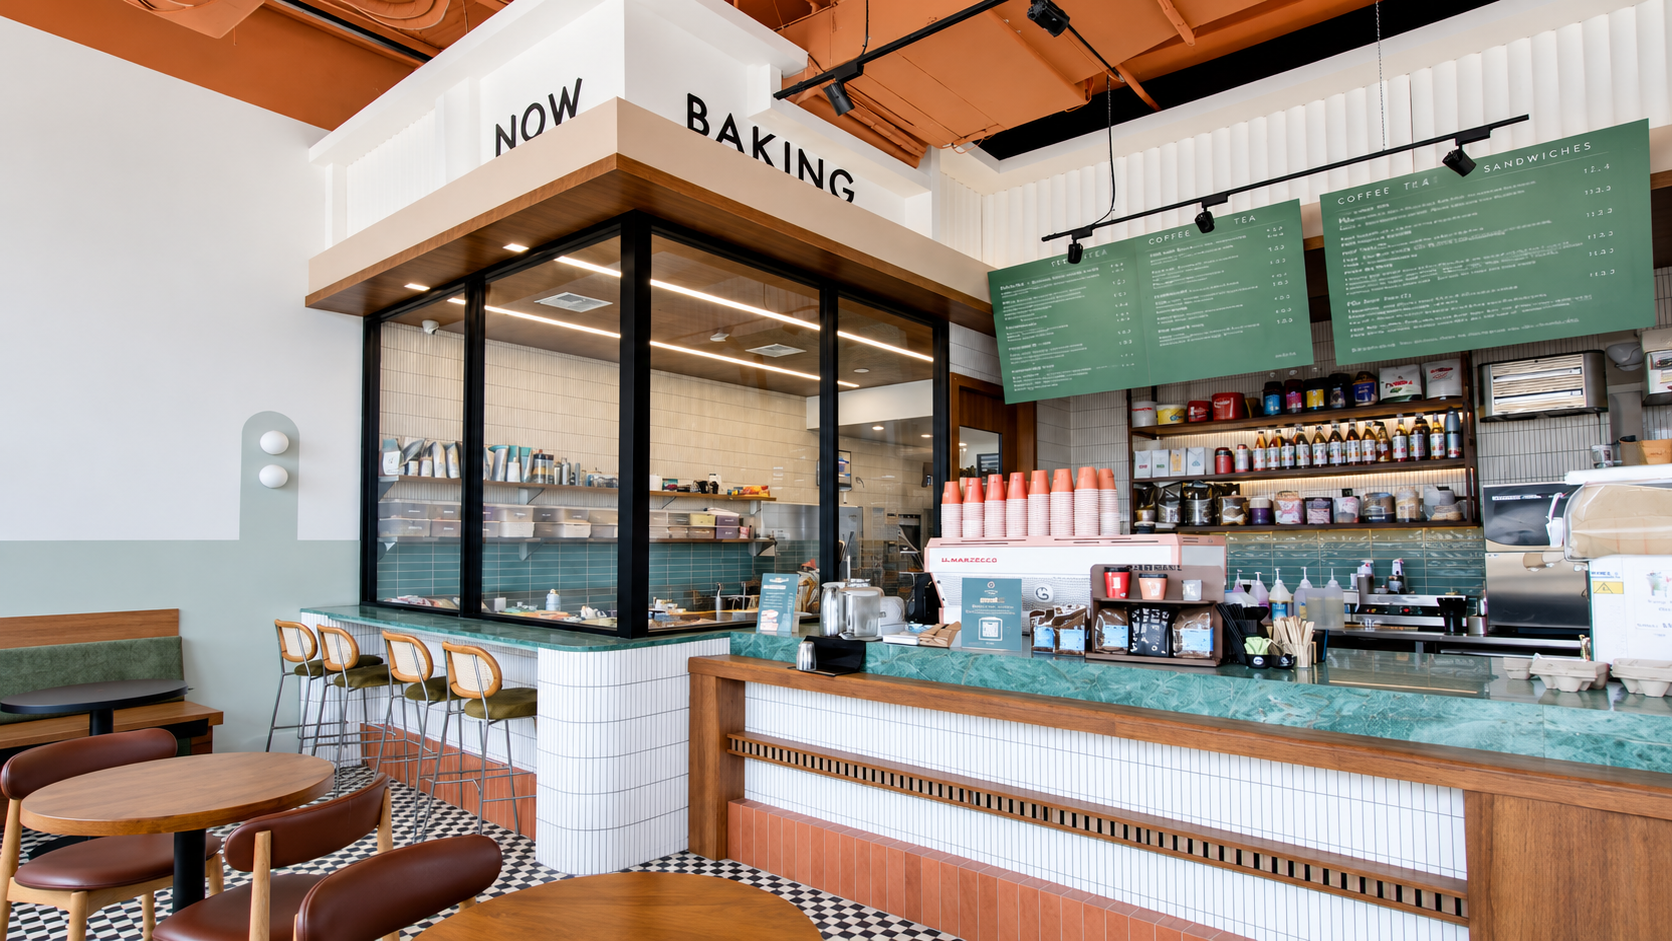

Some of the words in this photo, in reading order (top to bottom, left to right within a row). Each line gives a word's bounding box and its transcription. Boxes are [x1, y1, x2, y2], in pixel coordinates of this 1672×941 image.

[496, 78, 583, 157] NOW
[687, 93, 855, 204] BAKING
[1483, 141, 1592, 173] SANDWICHES
[1337, 186, 1390, 206] COFFEE
[1148, 229, 1191, 246] COFFEE
[1233, 214, 1256, 225] TEA
